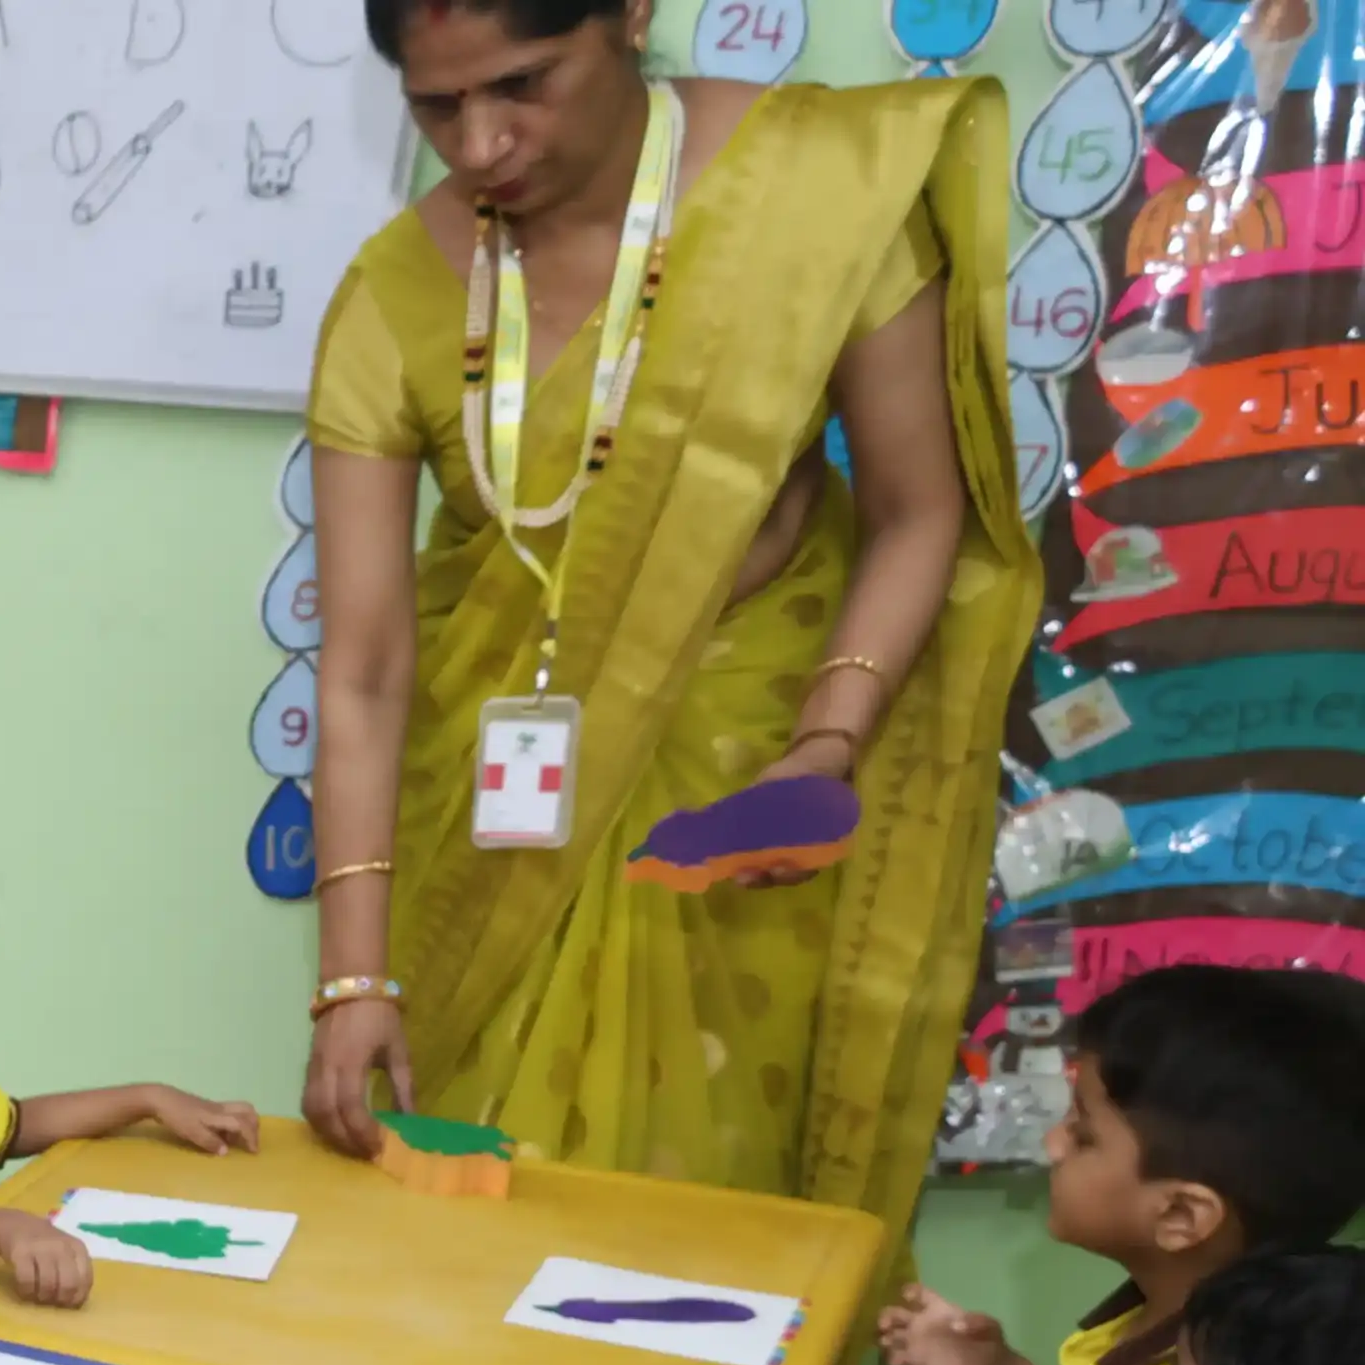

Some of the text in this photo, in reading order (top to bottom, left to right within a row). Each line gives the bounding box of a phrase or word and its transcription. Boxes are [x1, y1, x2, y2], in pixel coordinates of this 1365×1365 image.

[716, 4, 785, 52] 24
[1038, 127, 1114, 182] 45
[1011, 286, 1091, 338] 46
[1013, 443, 1048, 496] 7
[280, 707, 309, 747] 9
[264, 824, 313, 872] 10
